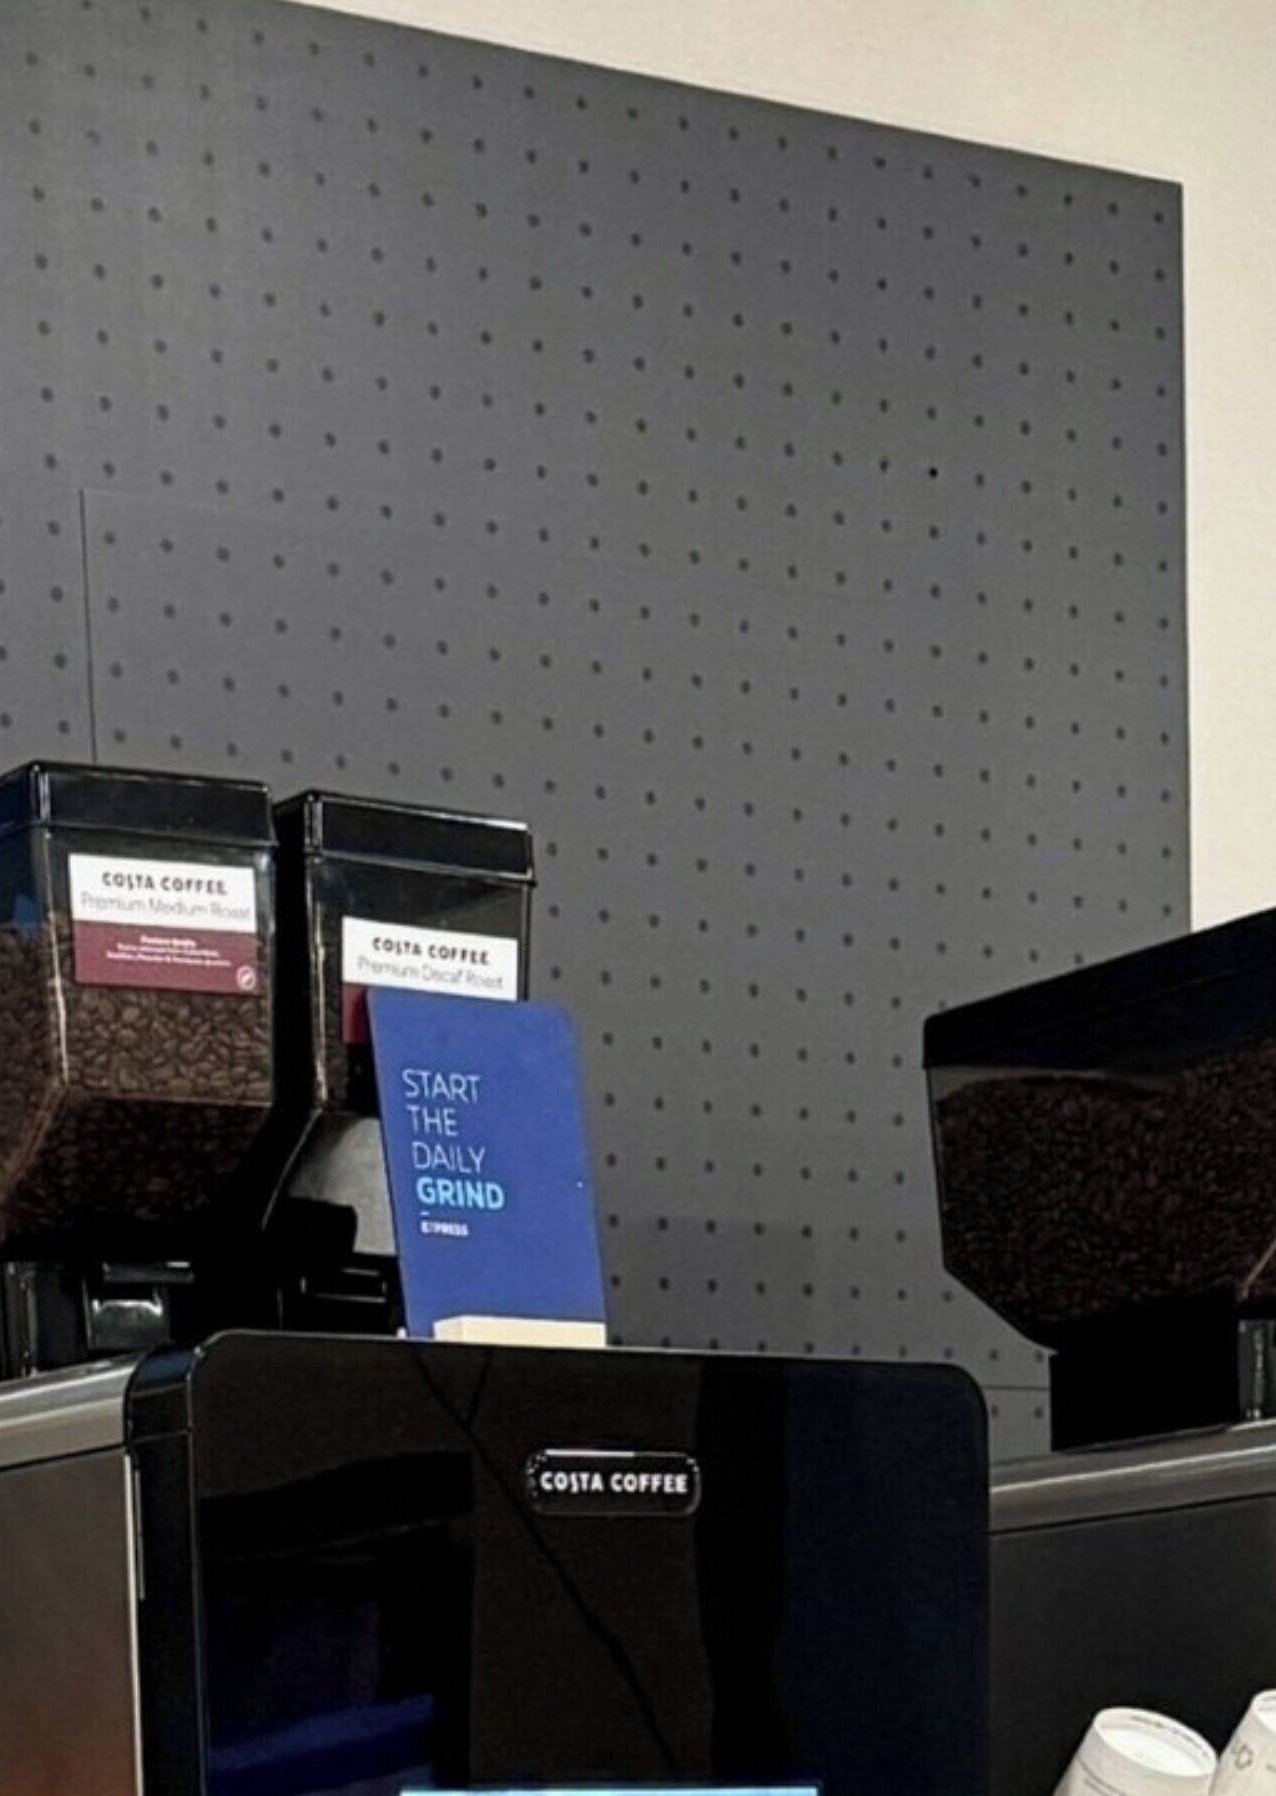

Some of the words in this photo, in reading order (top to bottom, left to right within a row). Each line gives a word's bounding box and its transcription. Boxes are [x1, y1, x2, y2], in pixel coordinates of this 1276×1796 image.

[102, 872, 156, 891] COSTA
[161, 877, 227, 895] COFFEE
[373, 937, 422, 955] COSTA
[427, 945, 490, 965] COFFEE
[401, 1068, 481, 1104] START
[405, 1104, 458, 1137] THE
[411, 1140, 486, 1174] DAILY
[415, 1176, 506, 1211] GRIND
[540, 1471, 604, 1494] COSTA
[610, 1472, 688, 1494] COFFEE
